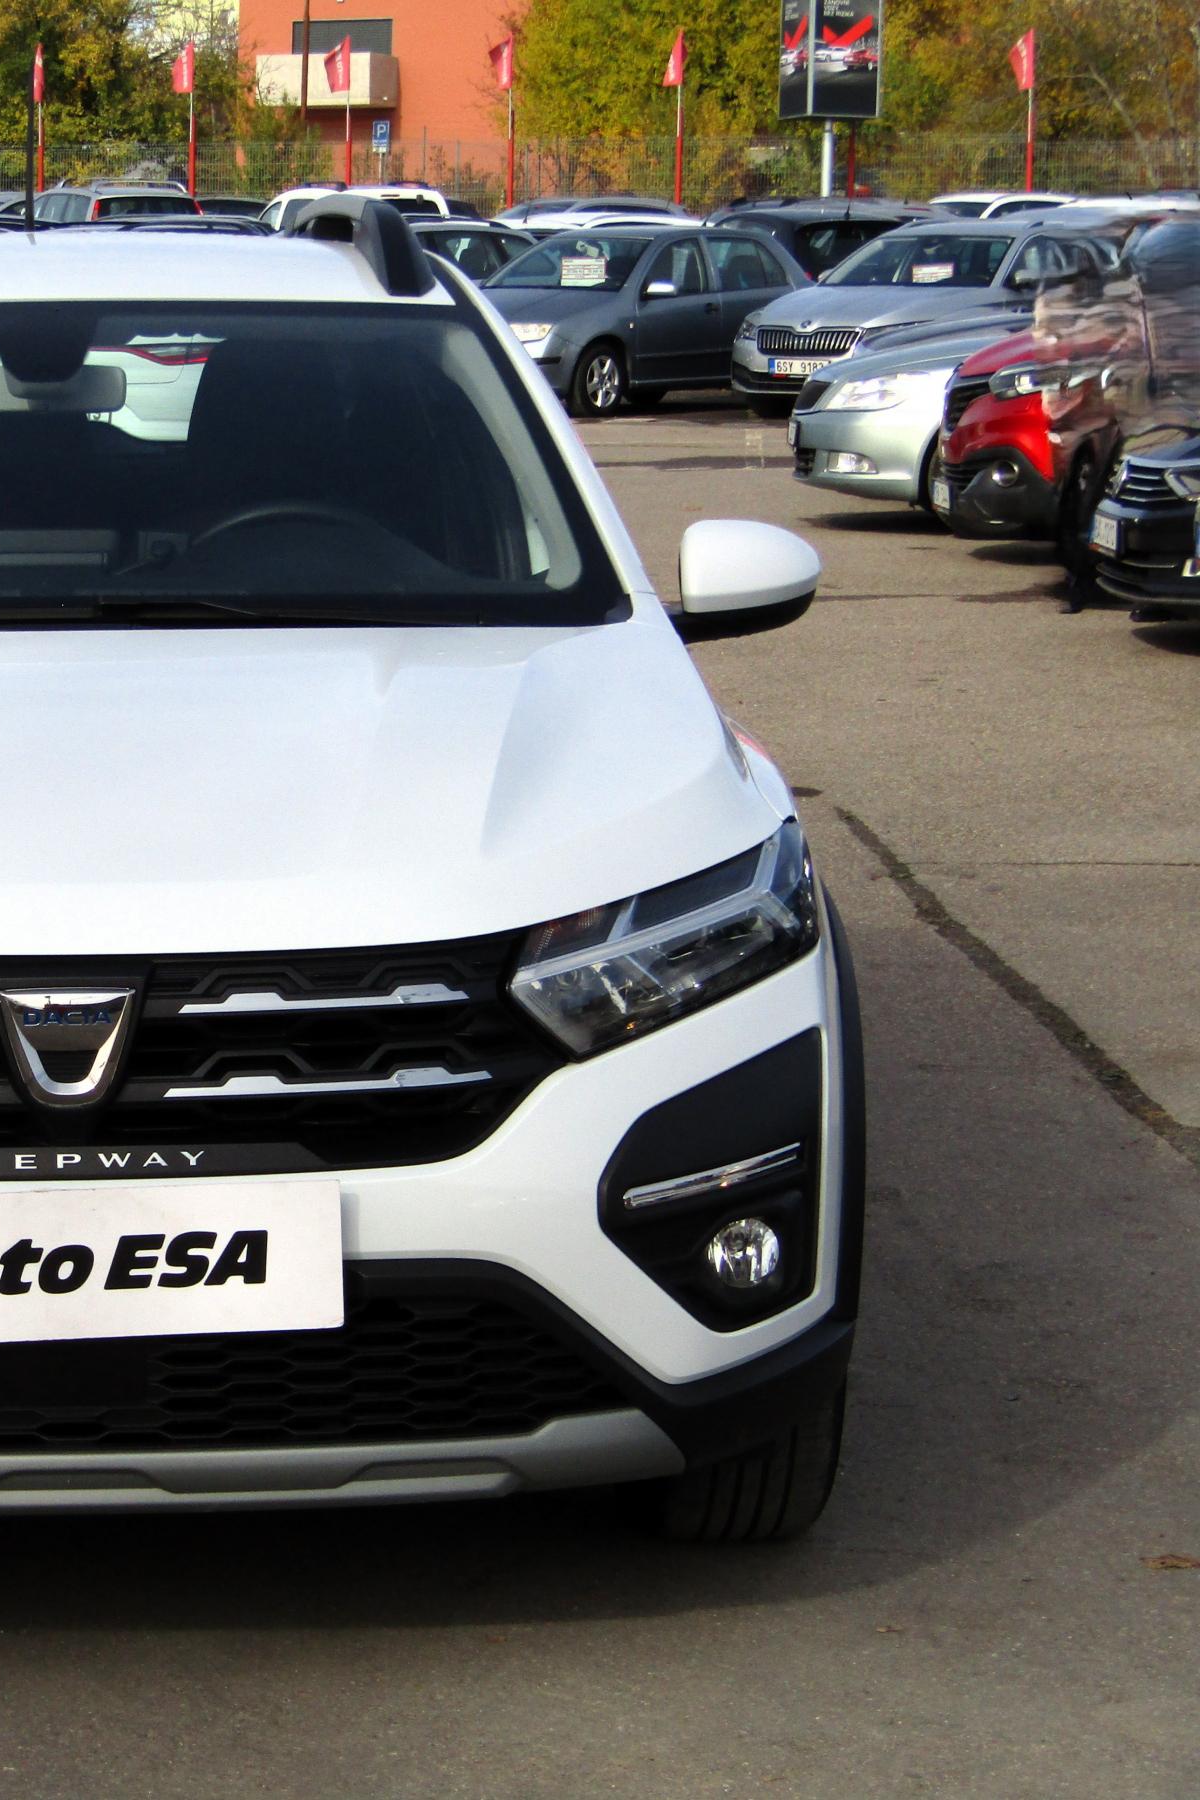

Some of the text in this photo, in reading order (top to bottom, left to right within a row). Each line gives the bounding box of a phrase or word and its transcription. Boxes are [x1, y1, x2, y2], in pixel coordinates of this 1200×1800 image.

[377, 124, 387, 138] P
[776, 361, 793, 373] 6SY
[23, 1007, 112, 1028] DACIA
[103, 1229, 269, 1290] ESA
